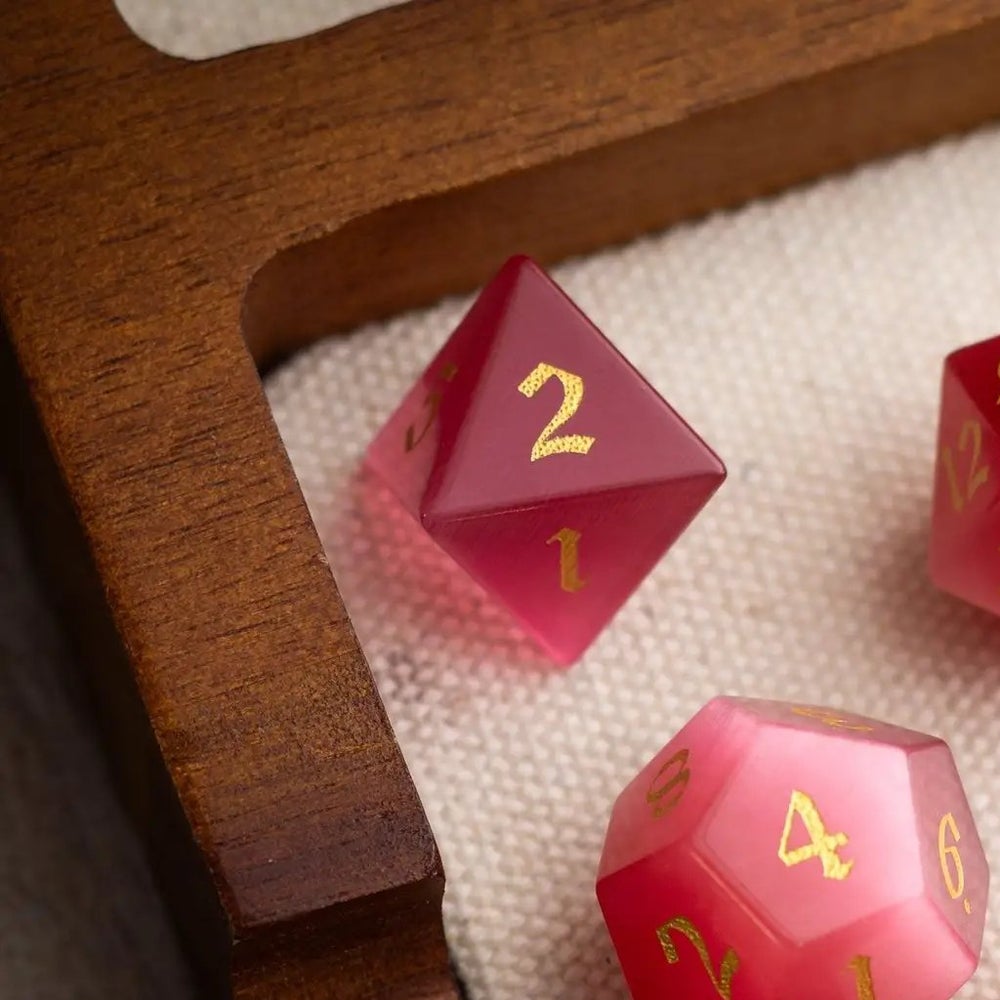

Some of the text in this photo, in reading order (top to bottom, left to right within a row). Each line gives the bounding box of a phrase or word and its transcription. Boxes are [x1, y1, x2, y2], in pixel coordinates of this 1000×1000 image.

[518, 362, 596, 462] 2
[545, 527, 588, 593] 1
[778, 789, 854, 881] 4
